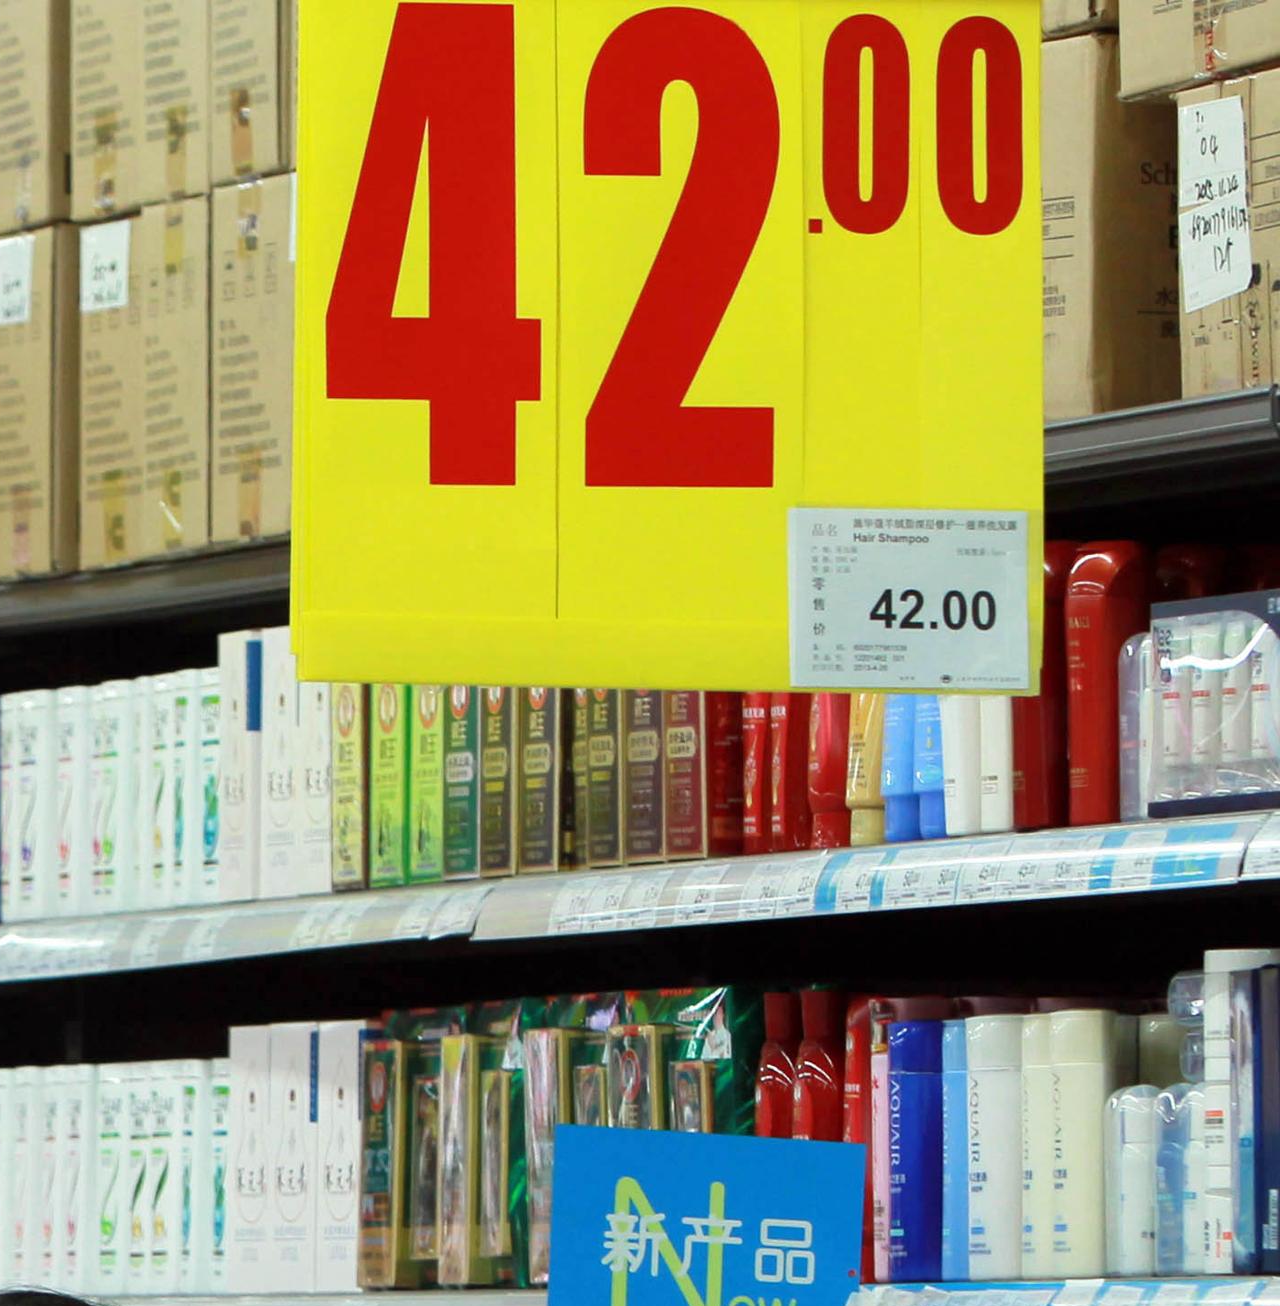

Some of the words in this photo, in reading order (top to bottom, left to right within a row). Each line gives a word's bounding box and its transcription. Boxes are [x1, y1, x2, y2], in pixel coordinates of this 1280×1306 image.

[327, 3, 1023, 488] 42.00
[853, 534, 875, 543] Hair
[878, 534, 929, 545] Shampoo
[869, 589, 996, 631] 42.00
[602, 1210, 816, 1286] 新产品
